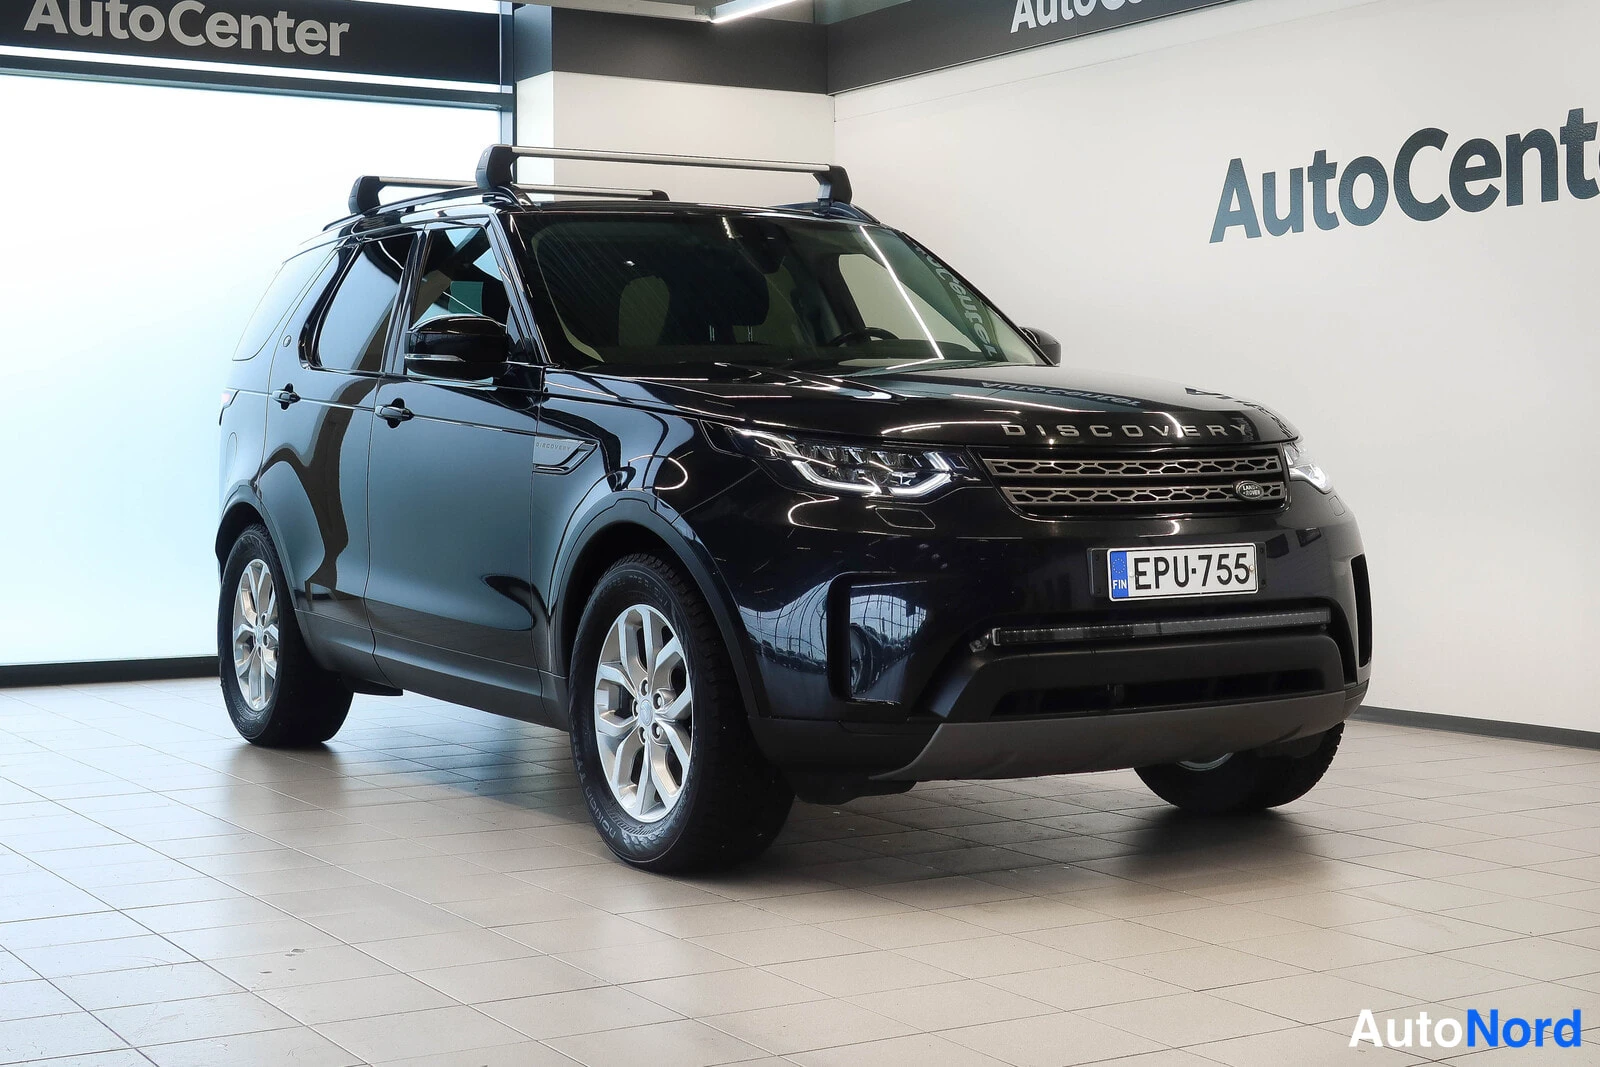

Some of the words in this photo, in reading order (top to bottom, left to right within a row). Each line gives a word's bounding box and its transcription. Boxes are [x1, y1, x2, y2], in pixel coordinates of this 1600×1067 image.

[24, 0, 350, 57] AutoCenter
[1209, 107, 1600, 243] AutoCent
[1001, 424, 1250, 438] DISCOVERY
[535, 442, 571, 451] DISCOVERY
[1112, 578, 1128, 590] FIN
